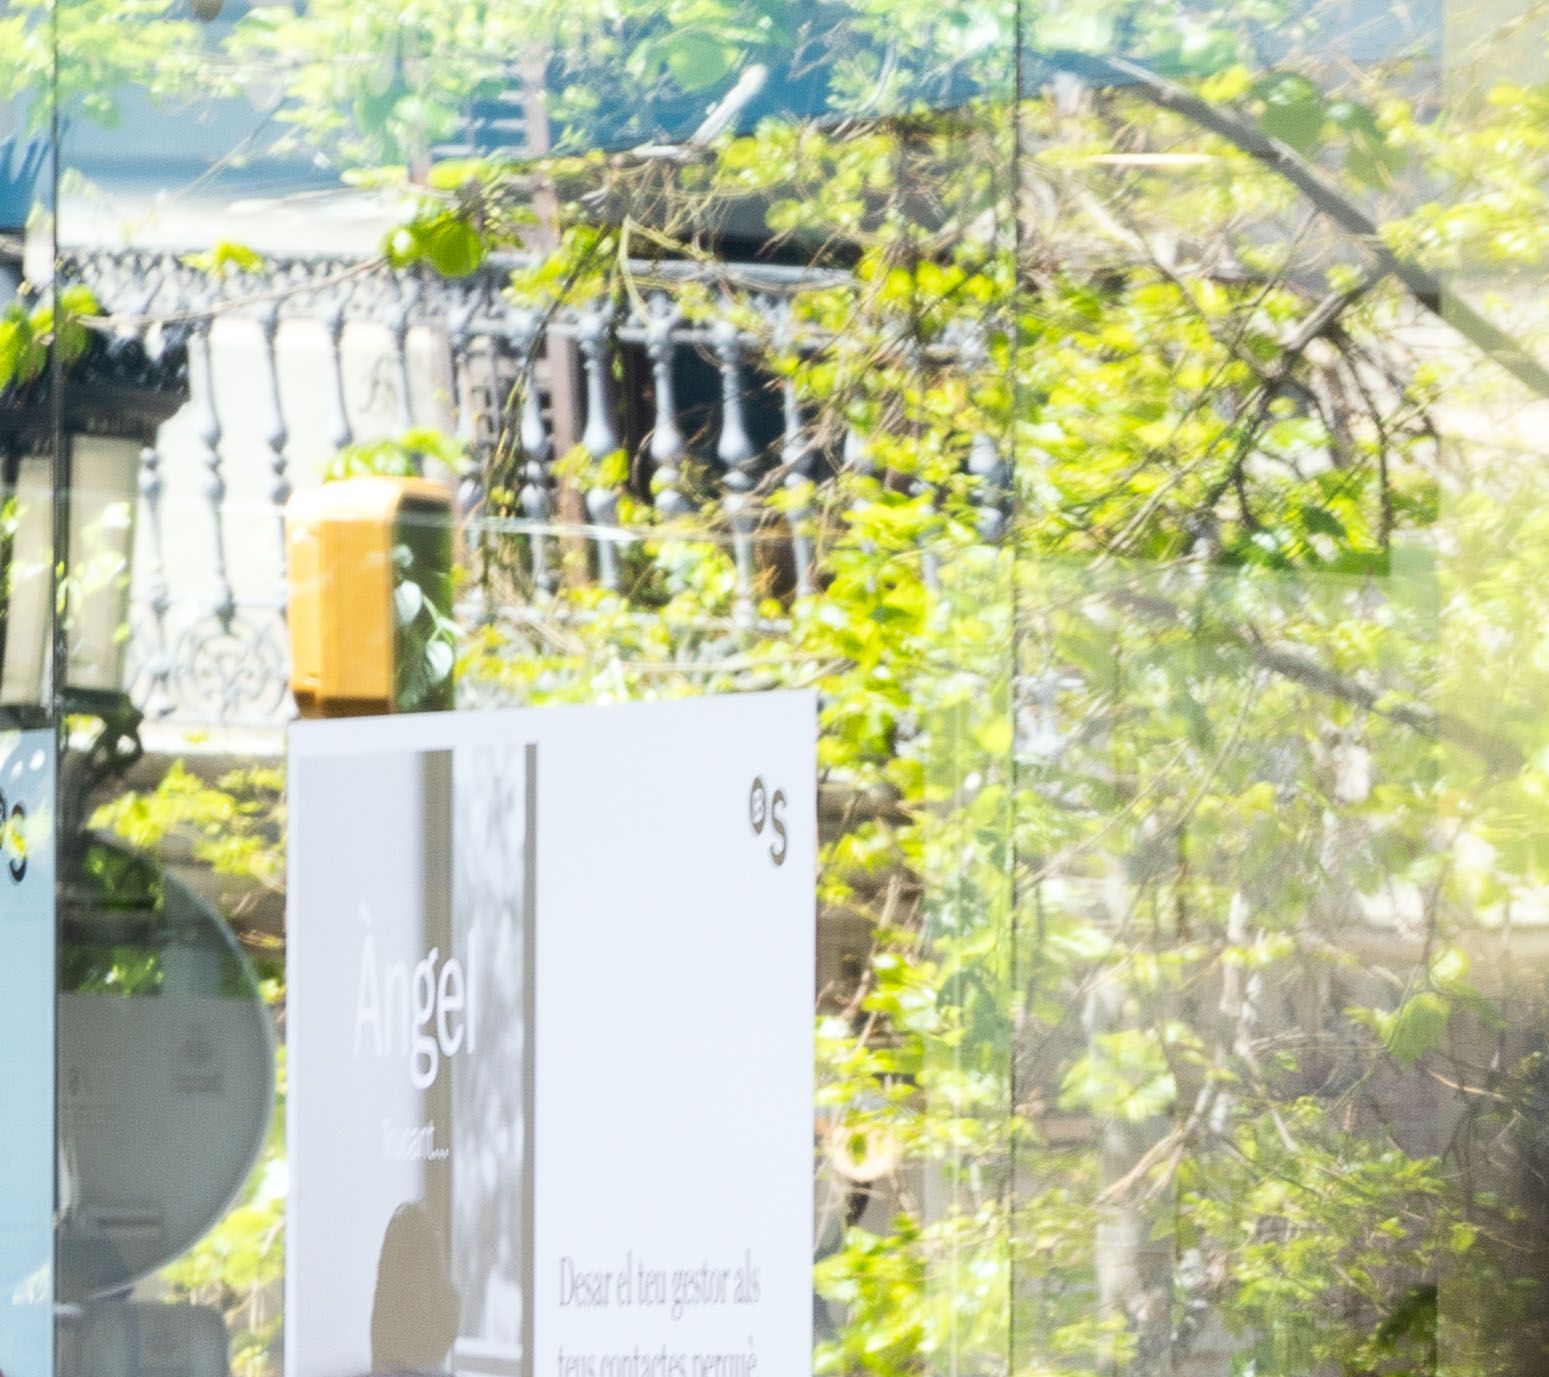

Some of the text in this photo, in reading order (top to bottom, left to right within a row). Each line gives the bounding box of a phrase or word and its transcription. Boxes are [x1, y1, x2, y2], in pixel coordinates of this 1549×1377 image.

[353, 898, 474, 1090] Àngel
[558, 1247, 760, 1321] Desar el teu gestor als
